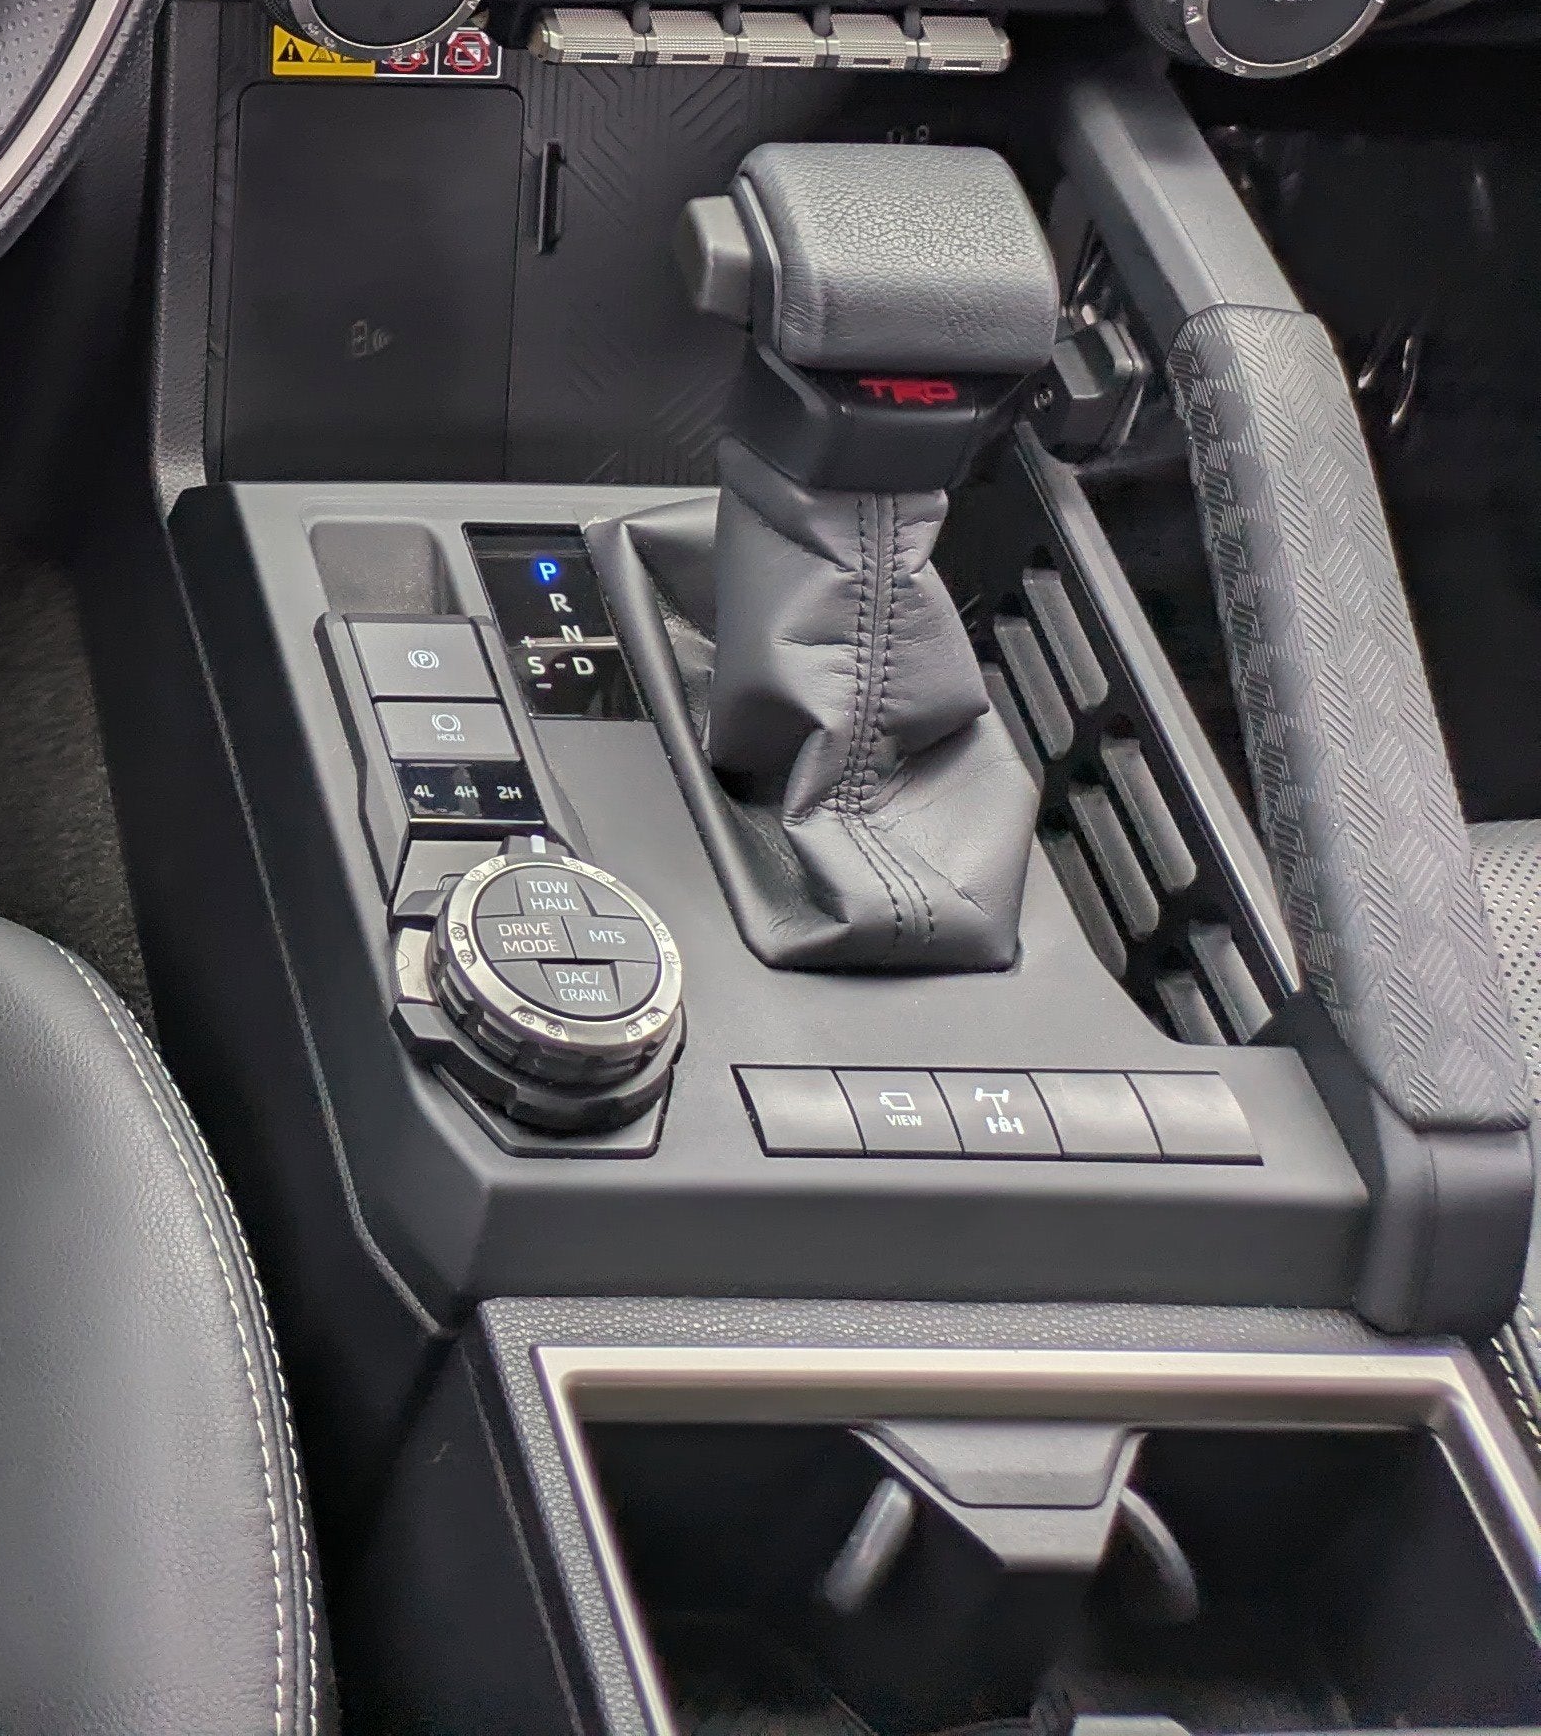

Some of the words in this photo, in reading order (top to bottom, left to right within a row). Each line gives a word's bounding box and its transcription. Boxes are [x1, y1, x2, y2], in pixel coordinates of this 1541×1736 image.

[858, 378, 959, 405] TRD
[538, 561, 557, 581] P
[549, 592, 573, 614] R
[560, 625, 584, 644] N
[527, 656, 546, 676] S
[571, 656, 596, 676] D
[436, 733, 465, 742] HOLD
[413, 784, 435, 798] 4L
[453, 784, 479, 799] 4H
[496, 785, 522, 800] 2H
[526, 879, 569, 895] TOW
[529, 896, 580, 912] HAUL
[497, 922, 553, 936] DRIVE
[588, 928, 627, 945] MTS
[502, 939, 561, 954] MODE
[555, 970, 600, 985] DAC/
[559, 987, 612, 1002] CRAWL
[885, 1113, 923, 1128] VIEW
